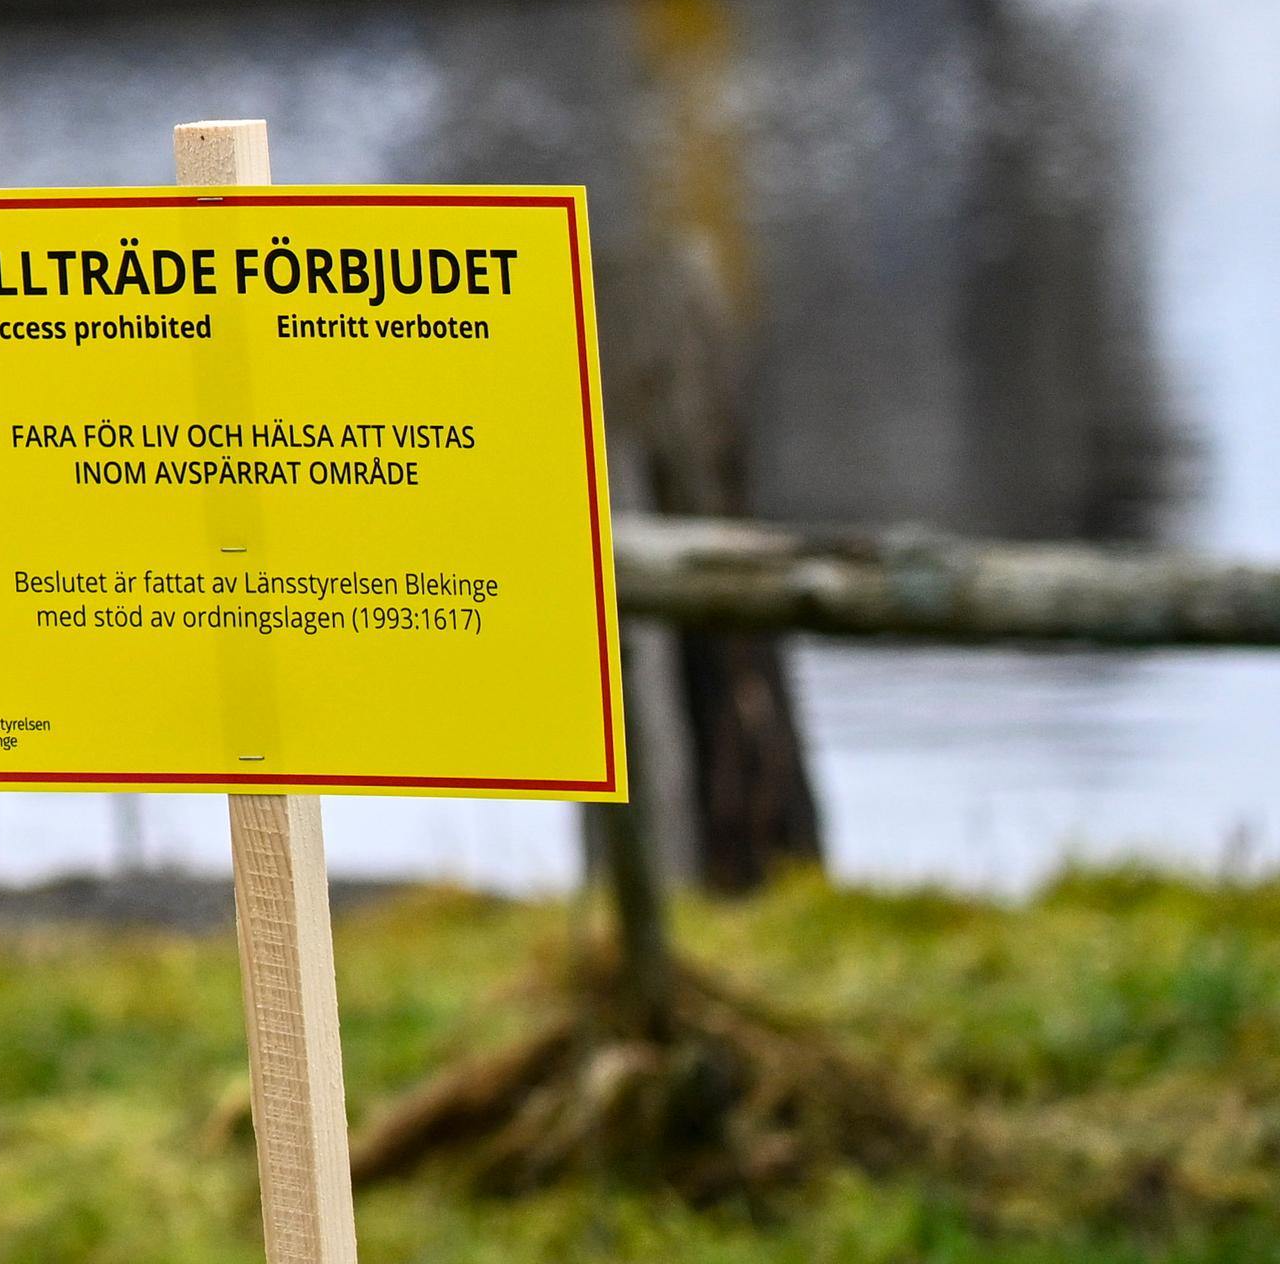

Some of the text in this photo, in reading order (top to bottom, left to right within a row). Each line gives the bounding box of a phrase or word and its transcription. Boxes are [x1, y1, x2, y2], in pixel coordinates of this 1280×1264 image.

[235, 236, 518, 307] FÖRBJUDET
[74, 313, 212, 347] prohibited
[277, 313, 489, 339] Eintritt verboten
[11, 418, 475, 449] FARA FÖR LIV OCH HÄLSA ATT VISTAS
[75, 455, 419, 486] INOM AVSPÄRRAT OMRÅDE
[14, 569, 498, 603] Beslutet är fattat av Länsstyrelsen Blekinge
[37, 604, 482, 636] med stöd av ordningslagen (1993:1617)
